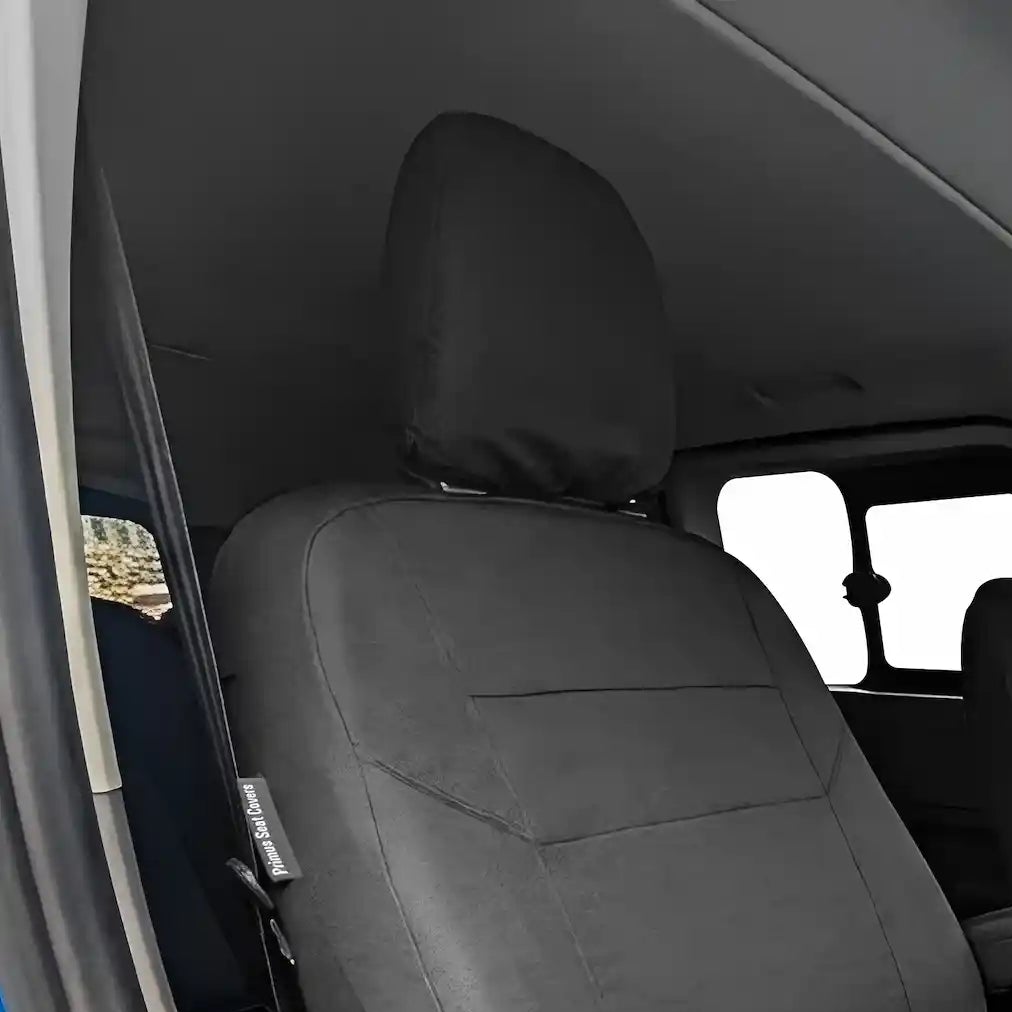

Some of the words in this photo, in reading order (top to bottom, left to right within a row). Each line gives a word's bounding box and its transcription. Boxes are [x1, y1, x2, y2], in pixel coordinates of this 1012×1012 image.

[243, 784, 263, 815] Covers
[251, 817, 271, 839] Seat
[262, 840, 289, 876] Primus
